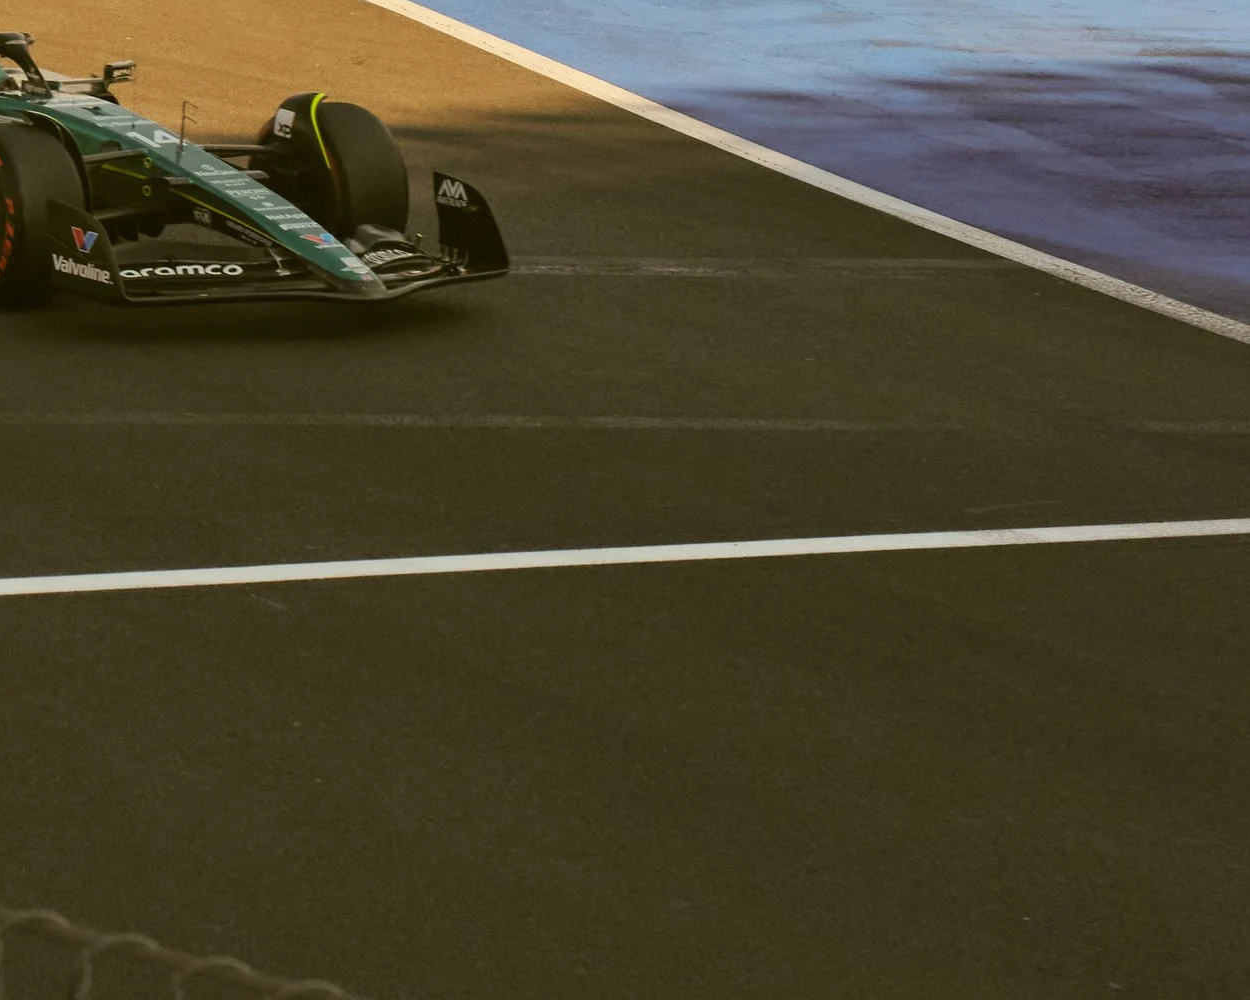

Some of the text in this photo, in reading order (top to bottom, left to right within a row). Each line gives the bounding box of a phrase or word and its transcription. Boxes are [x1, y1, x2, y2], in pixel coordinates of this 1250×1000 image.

[126, 129, 188, 149] 14
[52, 253, 112, 284] Valvoline
[119, 264, 244, 279] aramco
